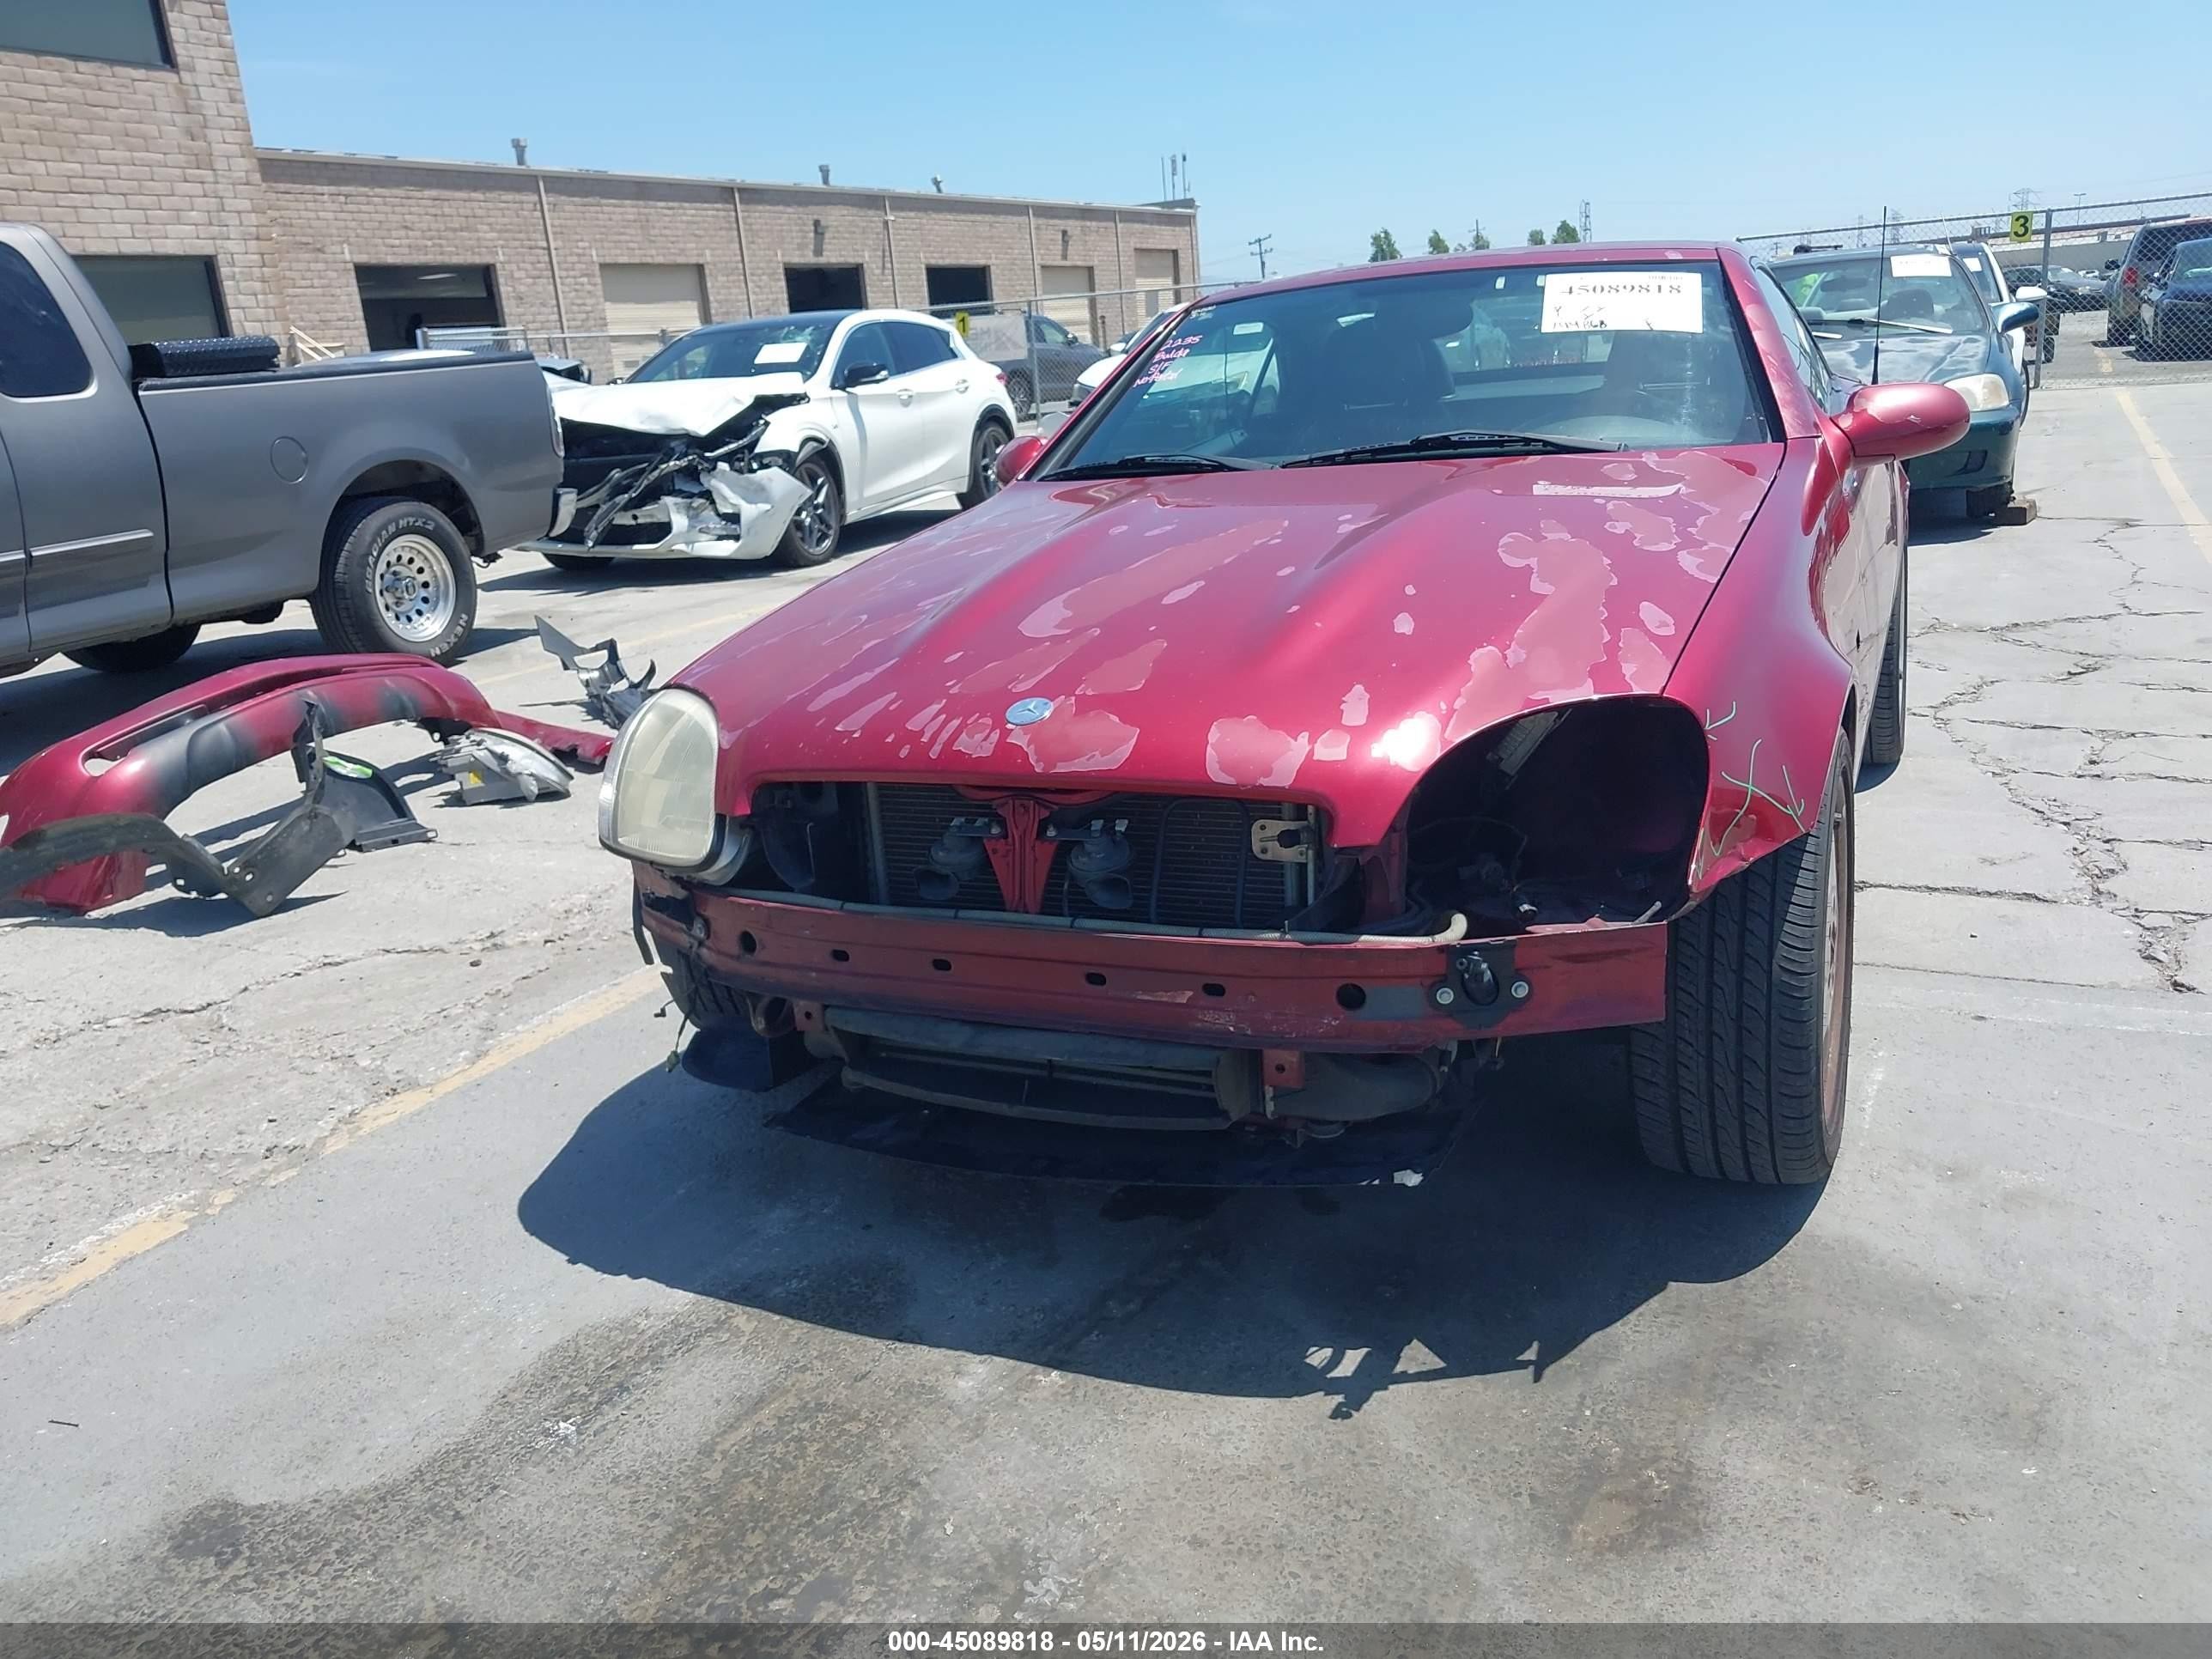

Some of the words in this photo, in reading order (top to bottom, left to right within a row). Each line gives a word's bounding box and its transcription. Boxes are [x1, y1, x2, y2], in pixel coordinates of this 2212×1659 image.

[2013, 216, 2029, 238] 3
[1559, 284, 1682, 295] 45089818
[958, 316, 966, 334] 1
[430, 613, 468, 658] NEXEN
